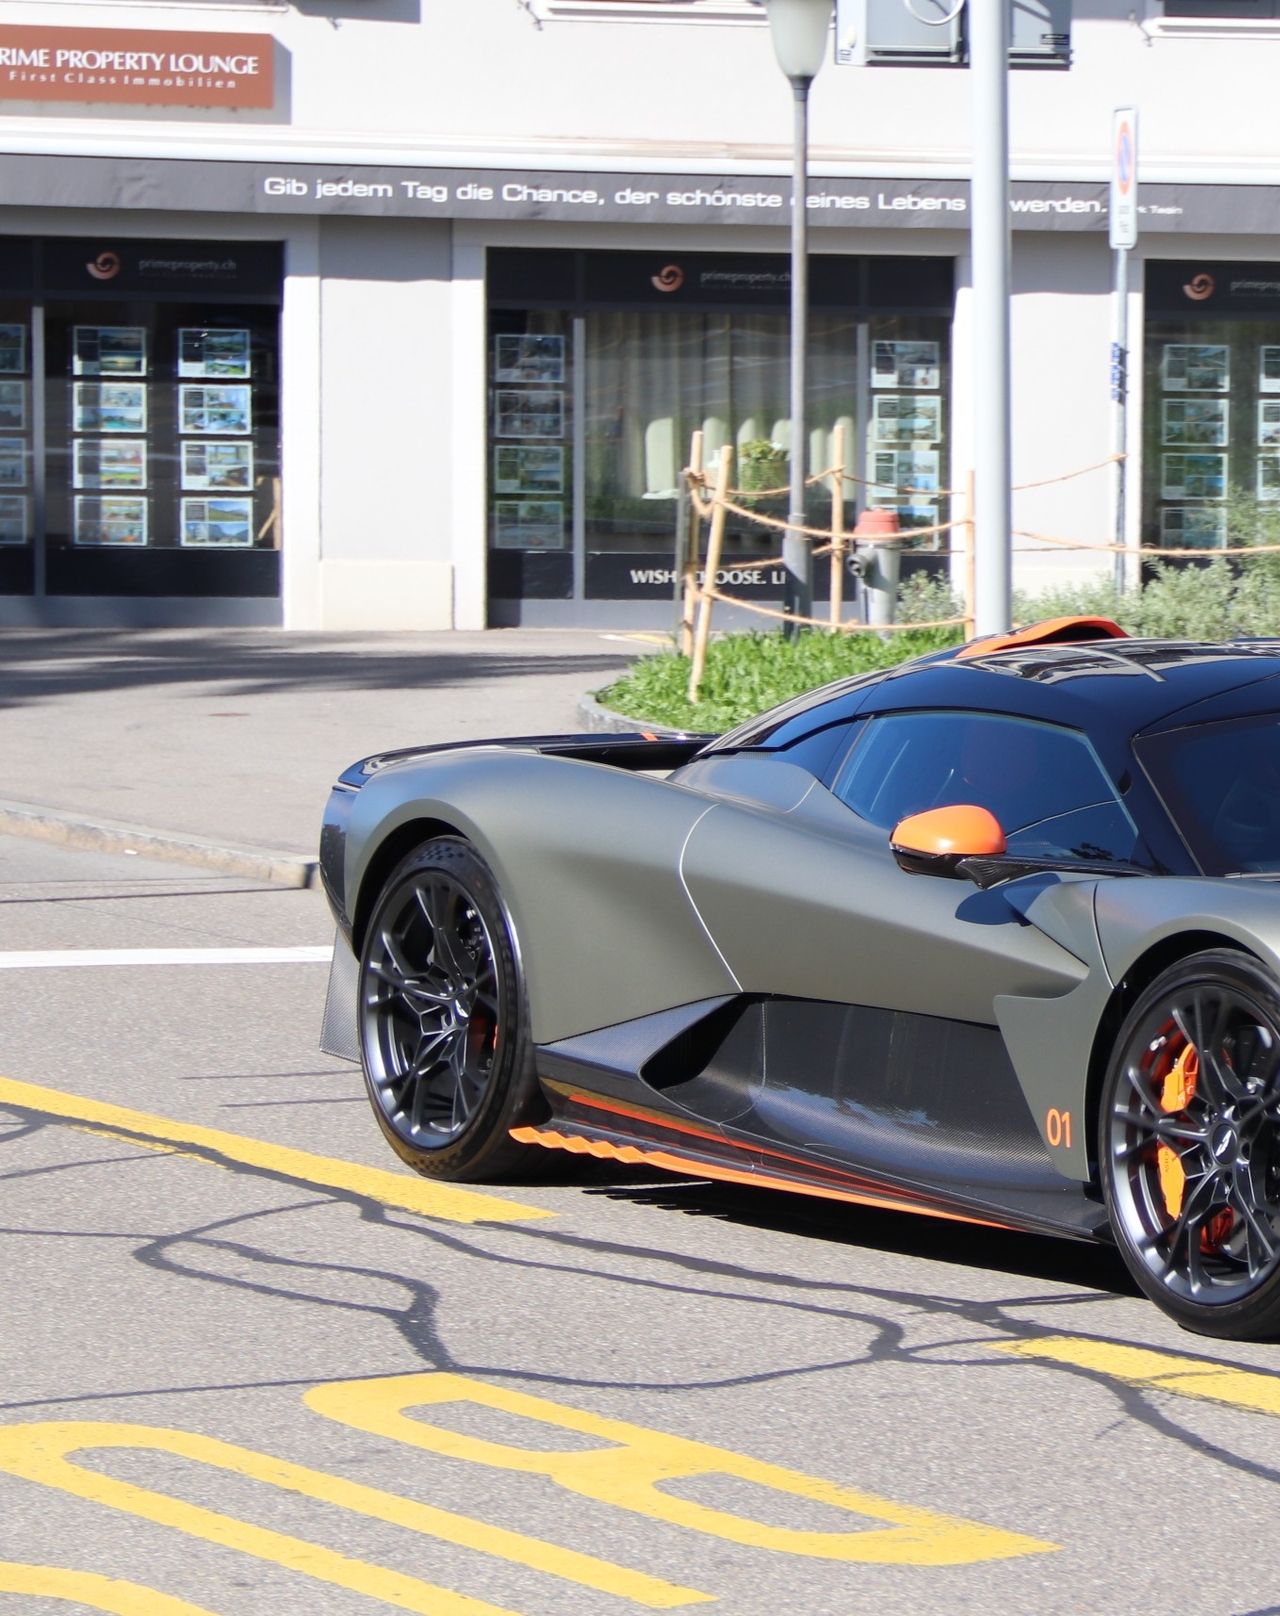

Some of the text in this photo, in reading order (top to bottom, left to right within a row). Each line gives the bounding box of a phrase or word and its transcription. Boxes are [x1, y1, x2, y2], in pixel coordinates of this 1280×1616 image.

[56, 49, 165, 71] PROPERTY
[170, 53, 259, 74] LOUNGE
[9, 70, 236, 89] First Class Immobilien
[264, 177, 308, 196] Gib
[315, 179, 393, 199] jedem
[401, 181, 448, 202] Tag
[456, 183, 494, 201] die
[502, 183, 605, 206] Chance,
[614, 187, 660, 205] der
[666, 189, 783, 208] schönste
[877, 193, 967, 211] Lebens
[1008, 196, 1108, 213] werden.
[1046, 1108, 1071, 1149] 01
